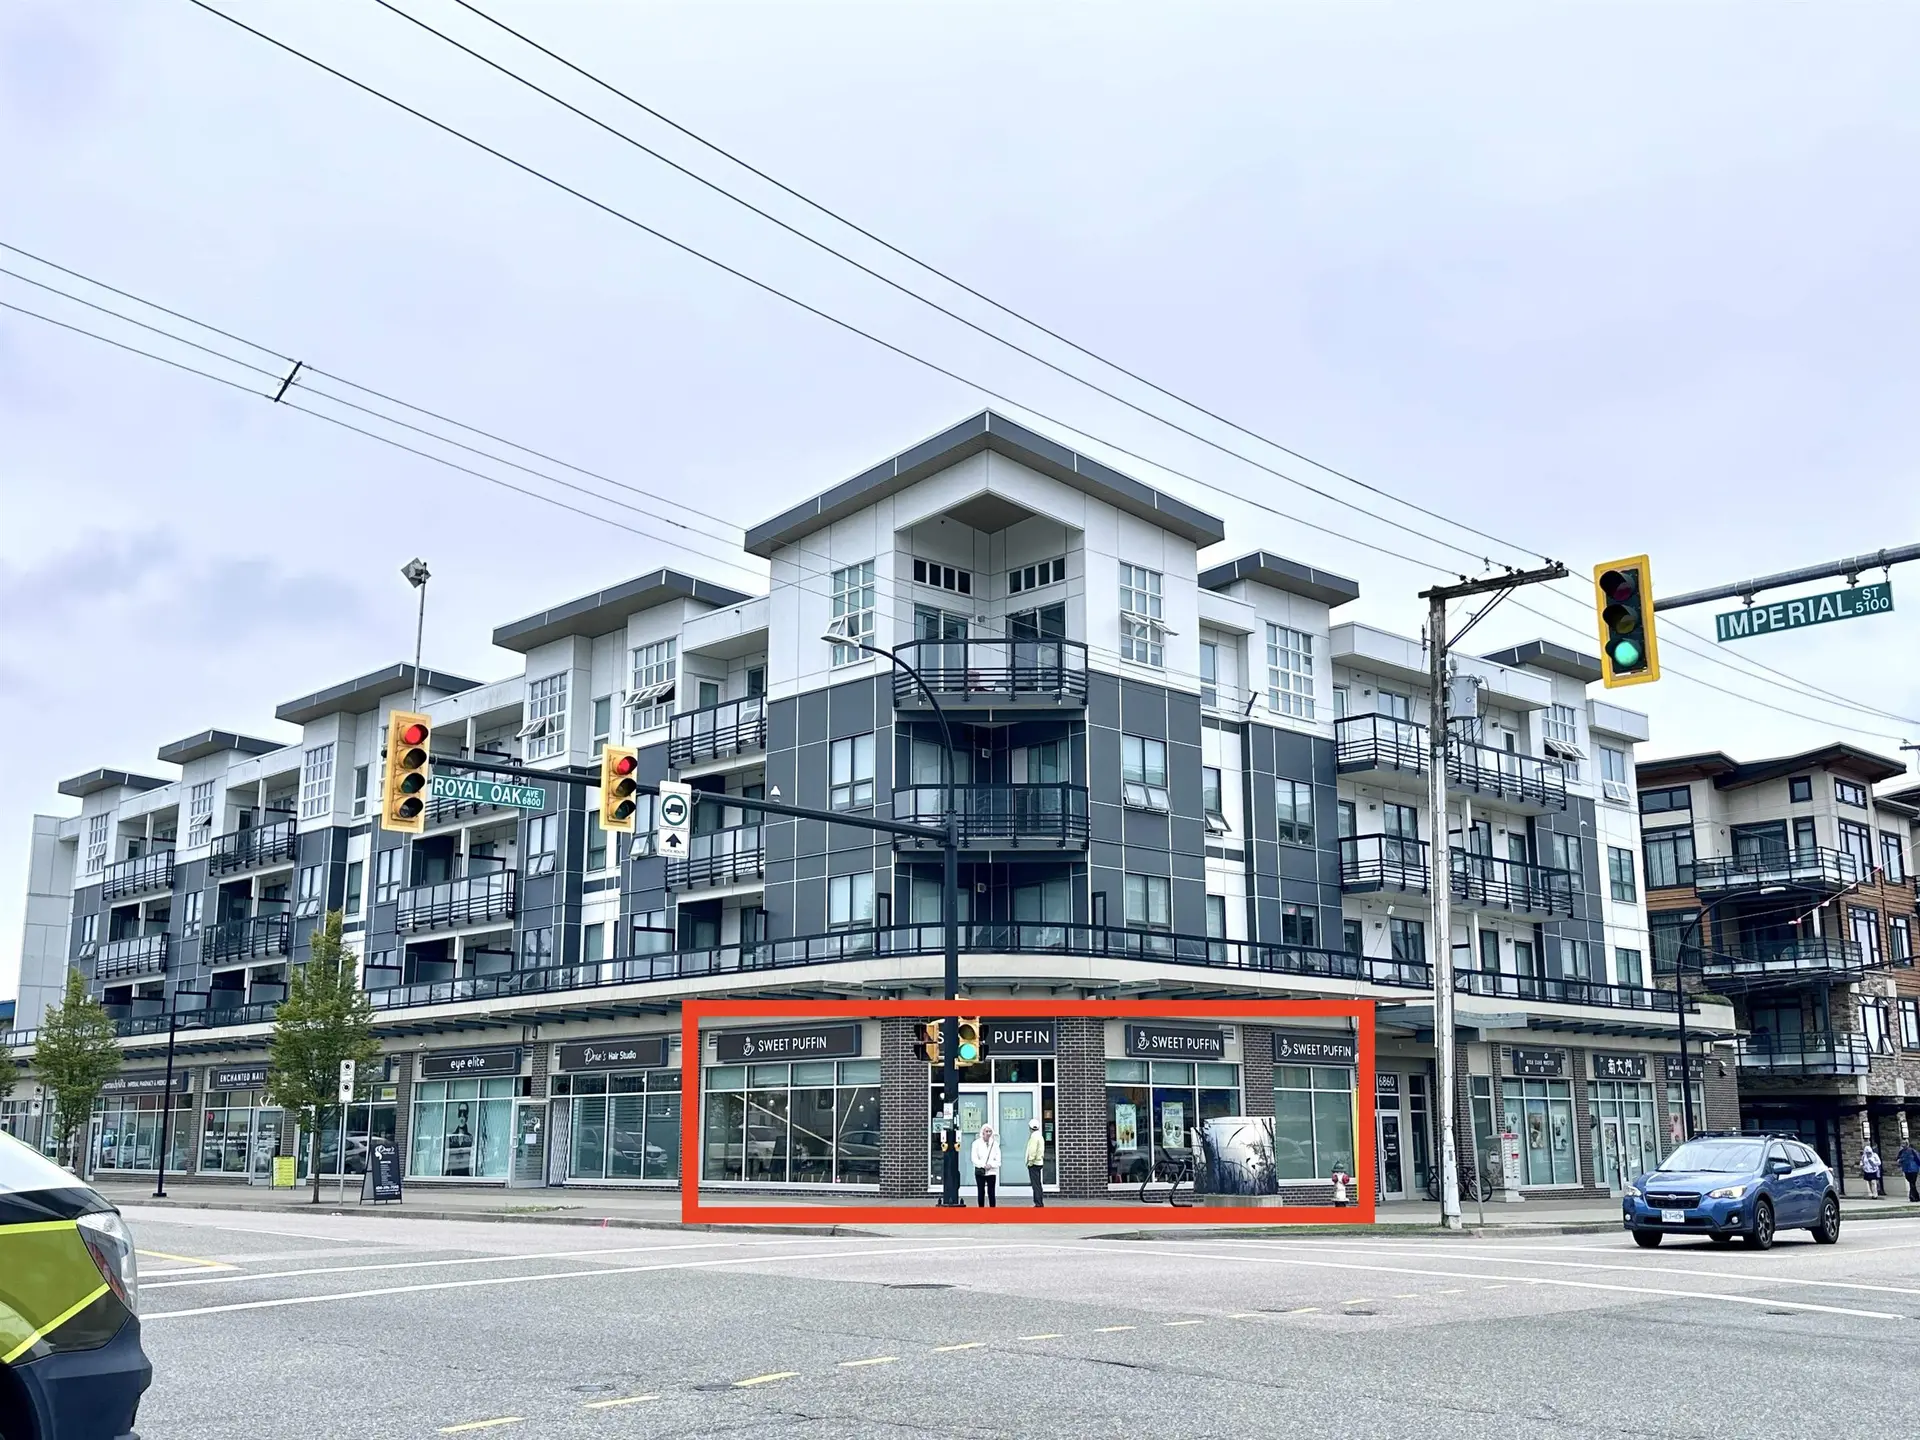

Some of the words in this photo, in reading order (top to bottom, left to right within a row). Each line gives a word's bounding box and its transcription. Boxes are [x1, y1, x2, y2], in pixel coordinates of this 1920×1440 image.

[1862, 587, 1880, 600] ST
[1855, 597, 1889, 613] 5100
[1719, 593, 1853, 638] IMPERIAL
[434, 778, 483, 800] ROYAL
[490, 785, 522, 805] OAK
[526, 789, 539, 798] AVE
[522, 796, 541, 807] 6800
[758, 1038, 790, 1052] SWEET
[792, 1036, 827, 1050] PUFFIN
[994, 1030, 1049, 1044] PUFFIN
[1152, 1035, 1184, 1049] SWEET
[1187, 1037, 1220, 1051] PUFFIN
[608, 1051, 619, 1060] Hair
[619, 1050, 637, 1060] Studio
[1293, 1043, 1321, 1055] SWEET
[1323, 1044, 1352, 1057] PUFFIN
[450, 1059, 466, 1072] eye
[467, 1055, 485, 1068] elite
[220, 1072, 250, 1083] ENCHANTED
[251, 1071, 265, 1081] NAIL
[1378, 1076, 1395, 1087] 6860
